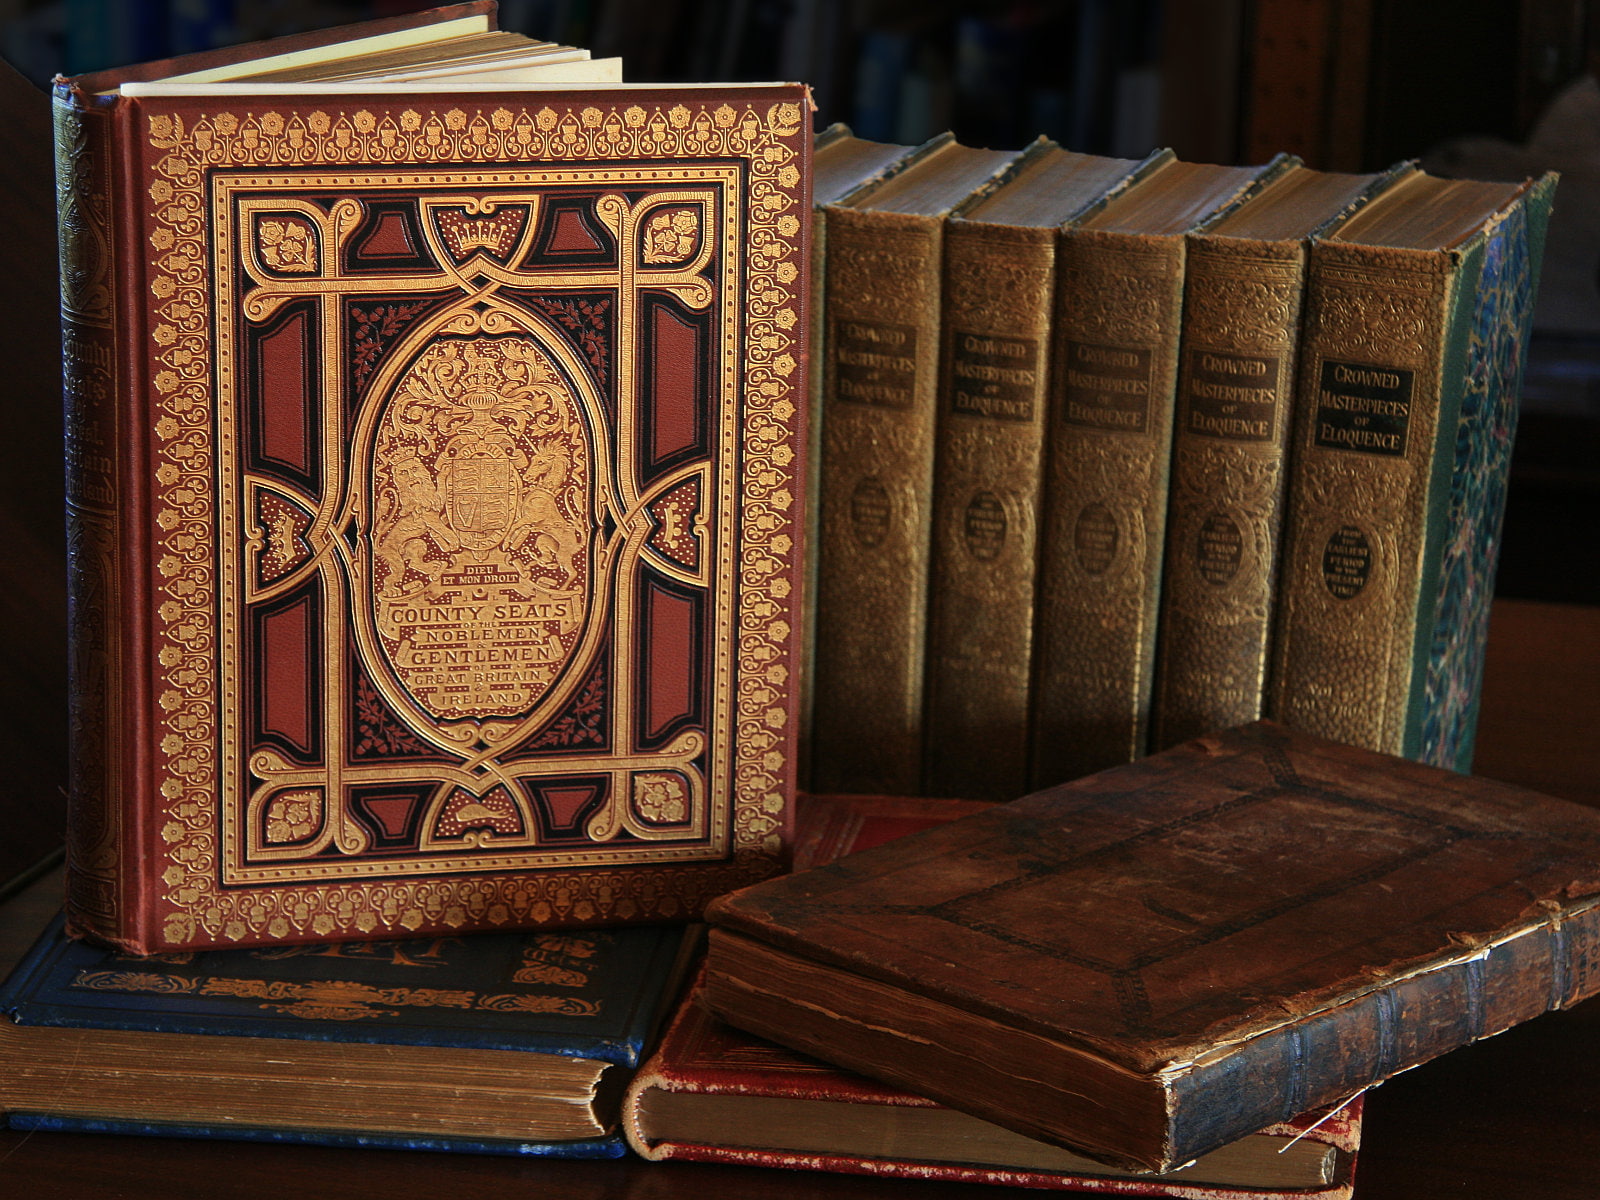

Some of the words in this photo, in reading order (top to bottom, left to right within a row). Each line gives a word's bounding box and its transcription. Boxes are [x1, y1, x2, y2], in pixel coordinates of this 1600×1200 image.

[1202, 353, 1267, 376] CROWNED
[1334, 365, 1400, 389] CROWNED
[1192, 378, 1276, 404] MASTERPIECES
[1321, 390, 1409, 417] MASTERPIECES
[1192, 411, 1269, 437] ELOQUENCE
[1320, 423, 1401, 450] ELOQUENCE
[442, 576, 456, 585] ET
[459, 575, 481, 584] MON
[484, 574, 518, 583] DROIT
[466, 566, 494, 575] DIEU
[391, 606, 484, 623] COUNTY
[494, 603, 567, 619] SEATS
[479, 620, 497, 628] THE
[427, 628, 540, 642] NOBLEMEN
[411, 647, 550, 665] GENTLEMEN
[415, 673, 466, 685] GREAT
[474, 670, 541, 683] BRITAIN
[442, 693, 522, 705] IRELAND
